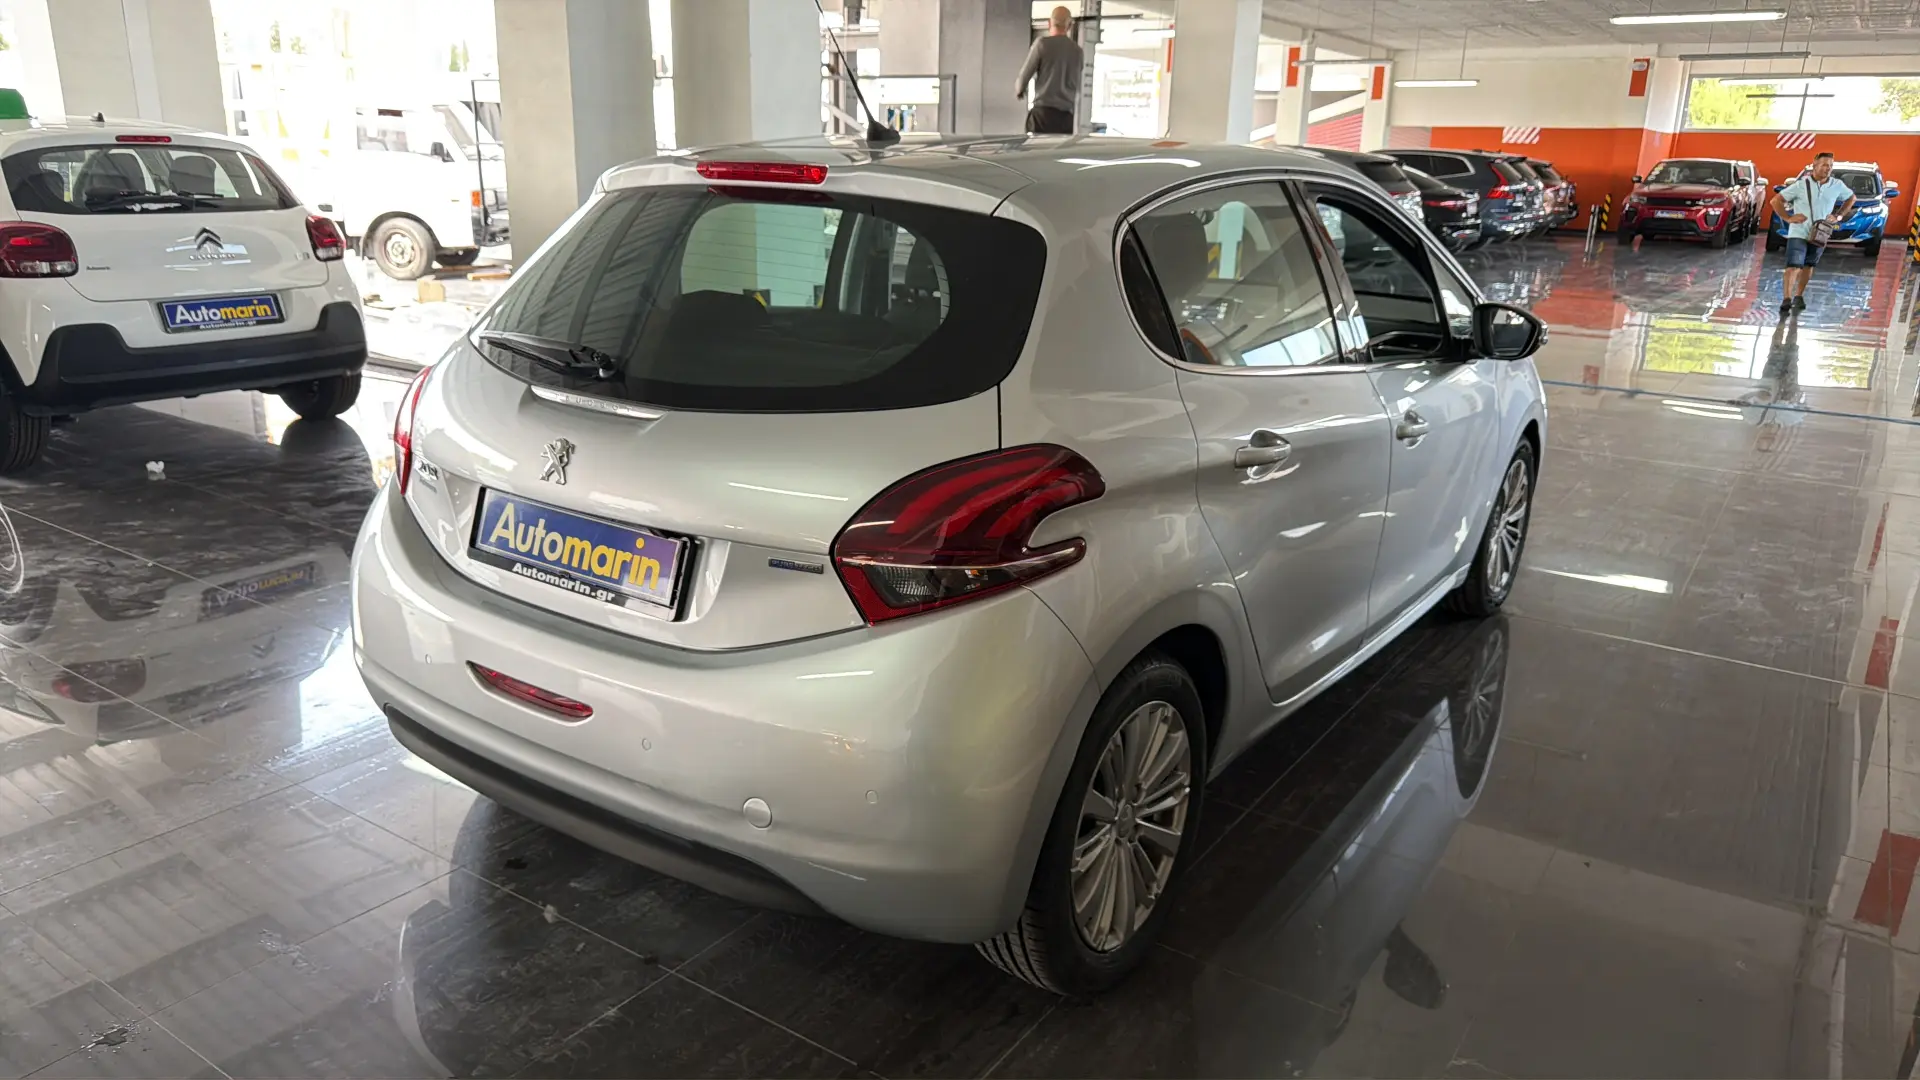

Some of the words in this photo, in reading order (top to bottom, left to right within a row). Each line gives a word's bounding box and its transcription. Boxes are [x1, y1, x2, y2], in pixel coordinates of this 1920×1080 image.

[175, 299, 272, 324] Automarin
[489, 502, 661, 590] Automarin
[511, 562, 616, 602] Automarin.gr
